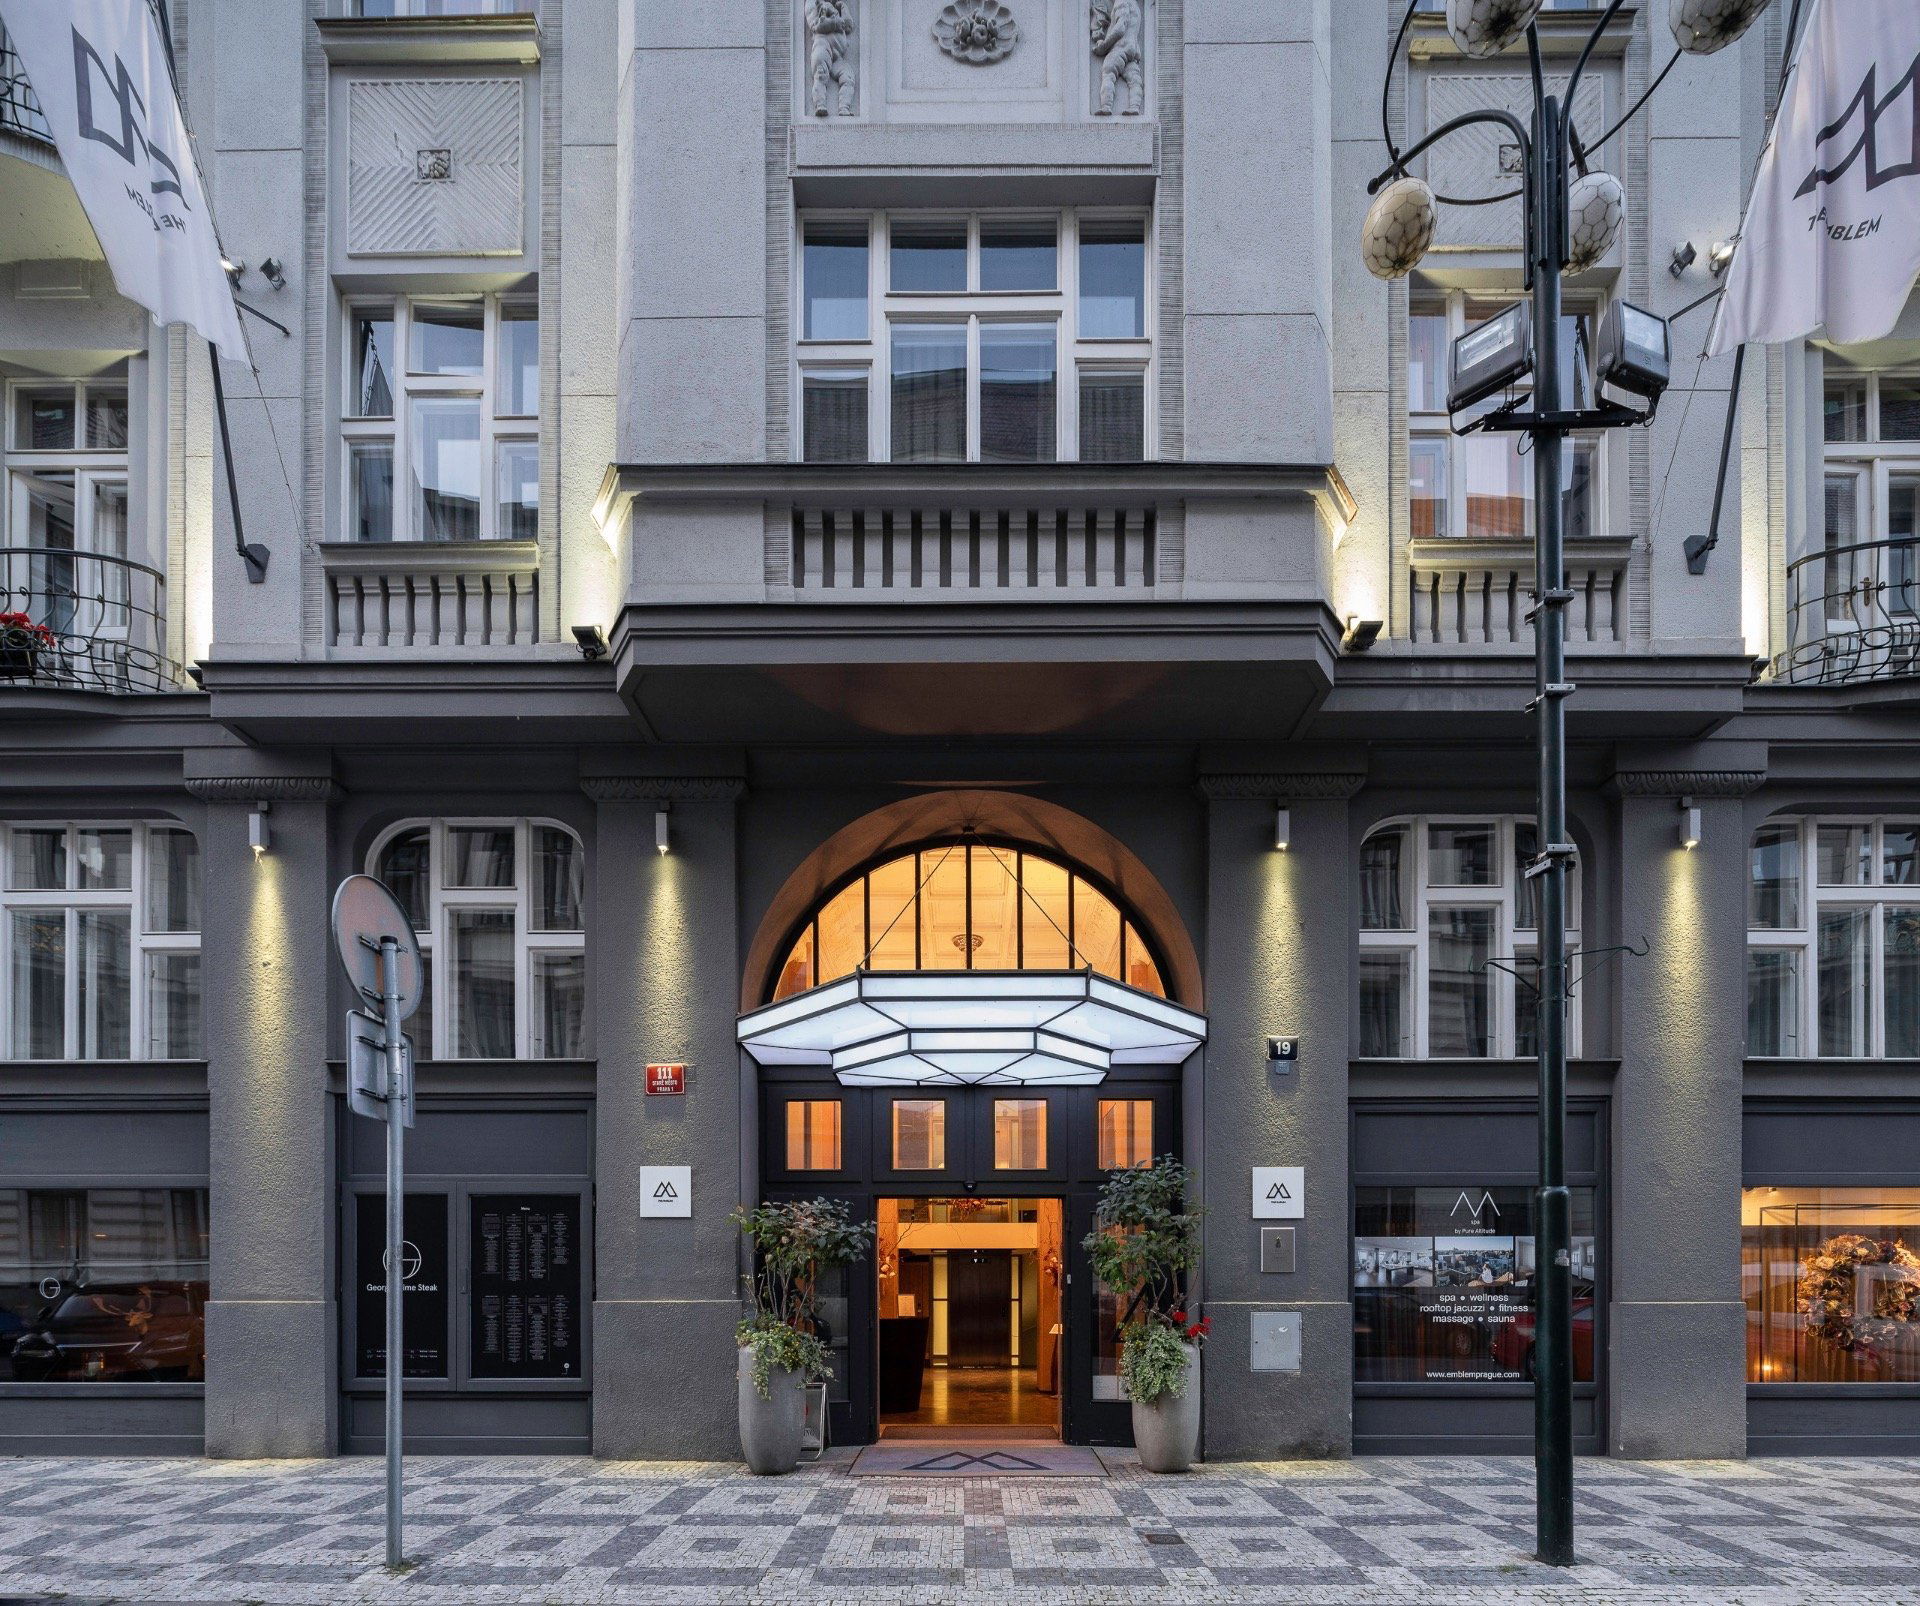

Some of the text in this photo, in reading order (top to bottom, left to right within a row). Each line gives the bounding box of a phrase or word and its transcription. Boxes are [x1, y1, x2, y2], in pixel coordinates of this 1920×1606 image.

[1275, 1041, 1291, 1055] 19
[657, 1067, 673, 1079] 111
[366, 1283, 438, 1293] Geor ime Steak
[1439, 1293, 1509, 1303] spa wellness
[1420, 1304, 1529, 1314] rooftop jacuzzi fitness
[1432, 1315, 1516, 1324] massage sauna
[1426, 1370, 1520, 1379] www.emblemprague.com
